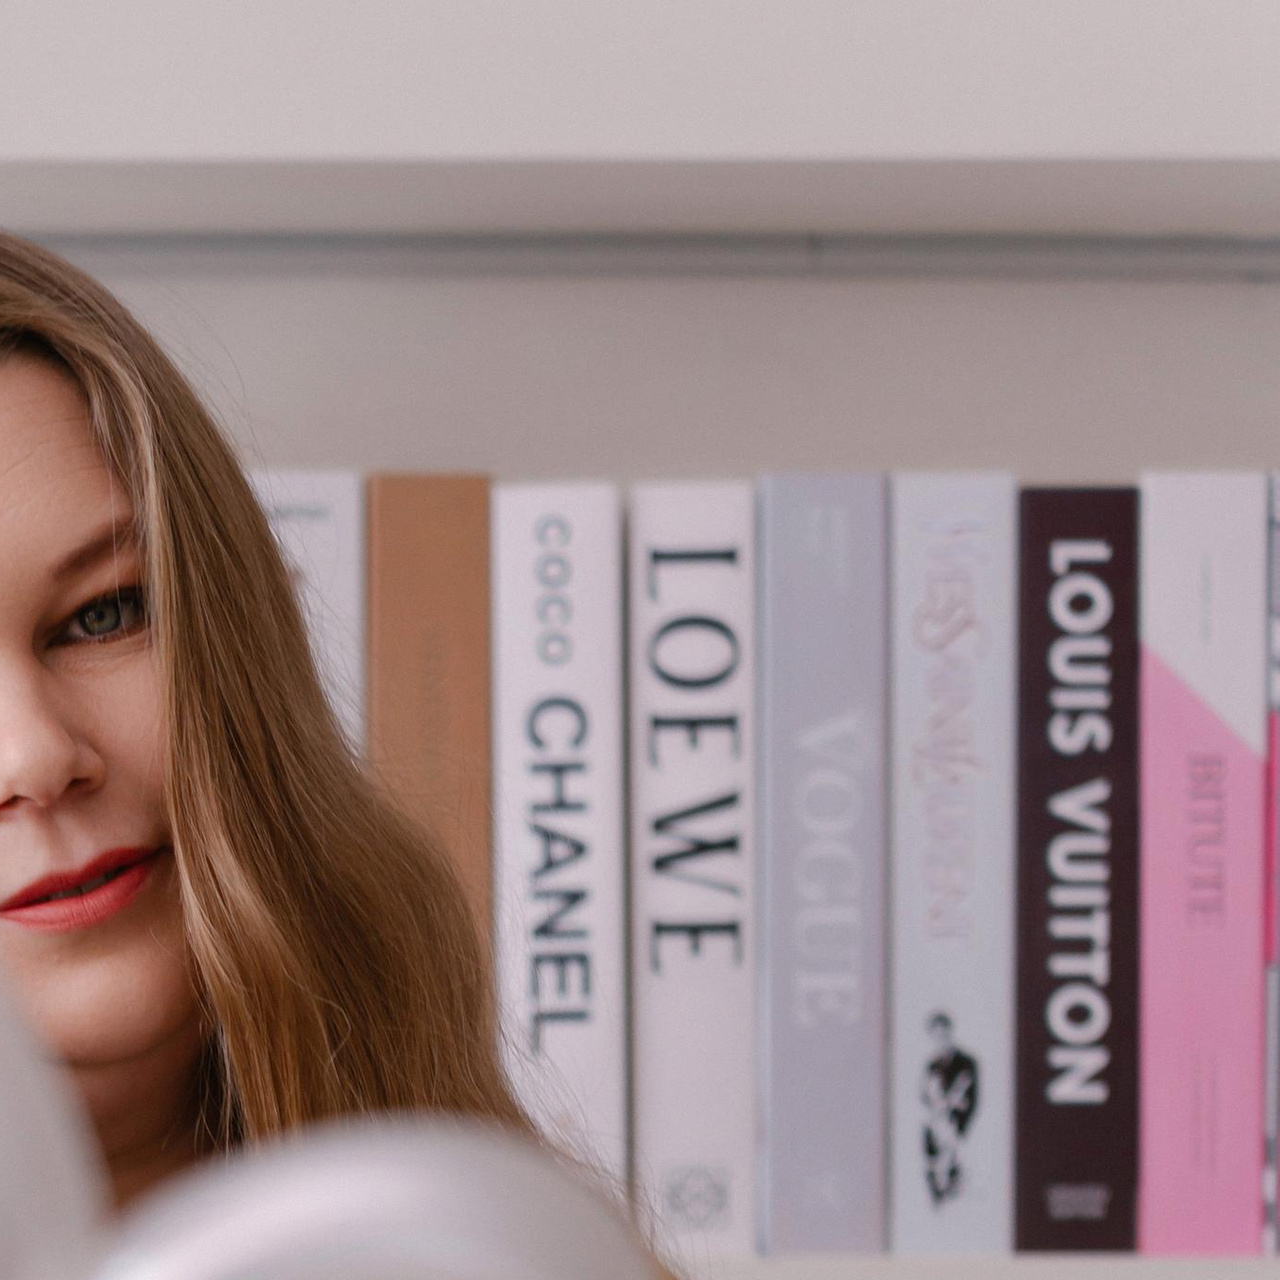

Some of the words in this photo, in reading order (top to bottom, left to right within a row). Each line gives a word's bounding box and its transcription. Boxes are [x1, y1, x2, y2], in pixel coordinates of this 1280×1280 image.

[534, 514, 574, 668] COCO
[1048, 538, 1113, 756] LOUIS
[526, 695, 592, 1054] CHANEL
[648, 546, 742, 972] LOEWE
[794, 711, 867, 1025] VOGUE
[1046, 778, 1111, 1105] VUITTON
